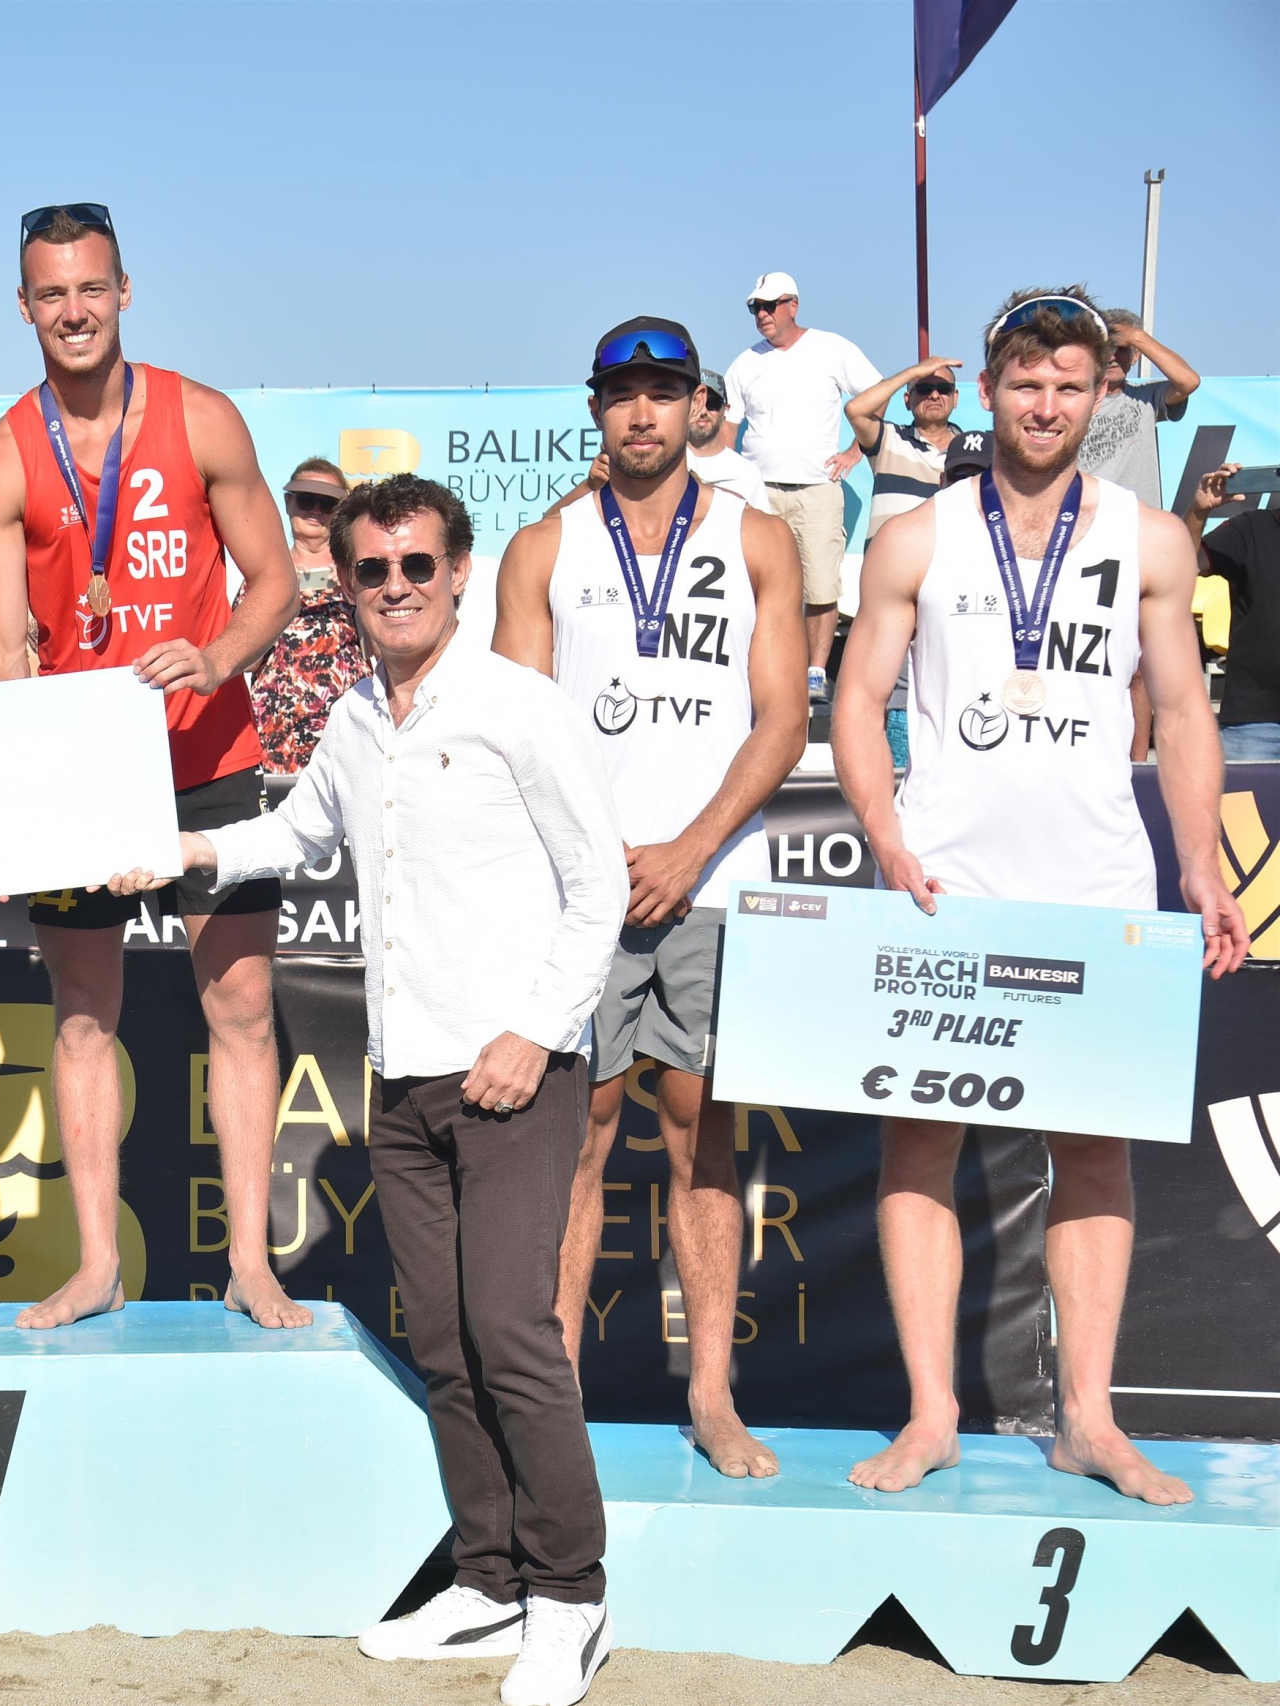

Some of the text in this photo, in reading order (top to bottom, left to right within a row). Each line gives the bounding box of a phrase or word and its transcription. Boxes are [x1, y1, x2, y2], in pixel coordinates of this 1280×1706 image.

[130, 468, 169, 521] 2
[126, 529, 187, 579] SRB
[688, 555, 726, 600] 2
[1080, 559, 1120, 609] 1
[112, 603, 173, 633] TVF
[662, 612, 730, 667] NZL
[652, 697, 712, 726] TVF
[1019, 714, 1090, 746] TVF
[778, 832, 869, 878] HO
[801, 903, 822, 911] CEV
[875, 954, 979, 983] BEACH
[877, 945, 979, 960] VOLLEYBALL WORLD
[874, 978, 977, 1000] PRO TOUR
[989, 965, 1079, 984] BALIKESIR
[1003, 992, 1062, 1005] FUTURES
[933, 1013, 1023, 1047] PLACE
[860, 1065, 1024, 1111] € 500
[1011, 1527, 1086, 1666] 3
